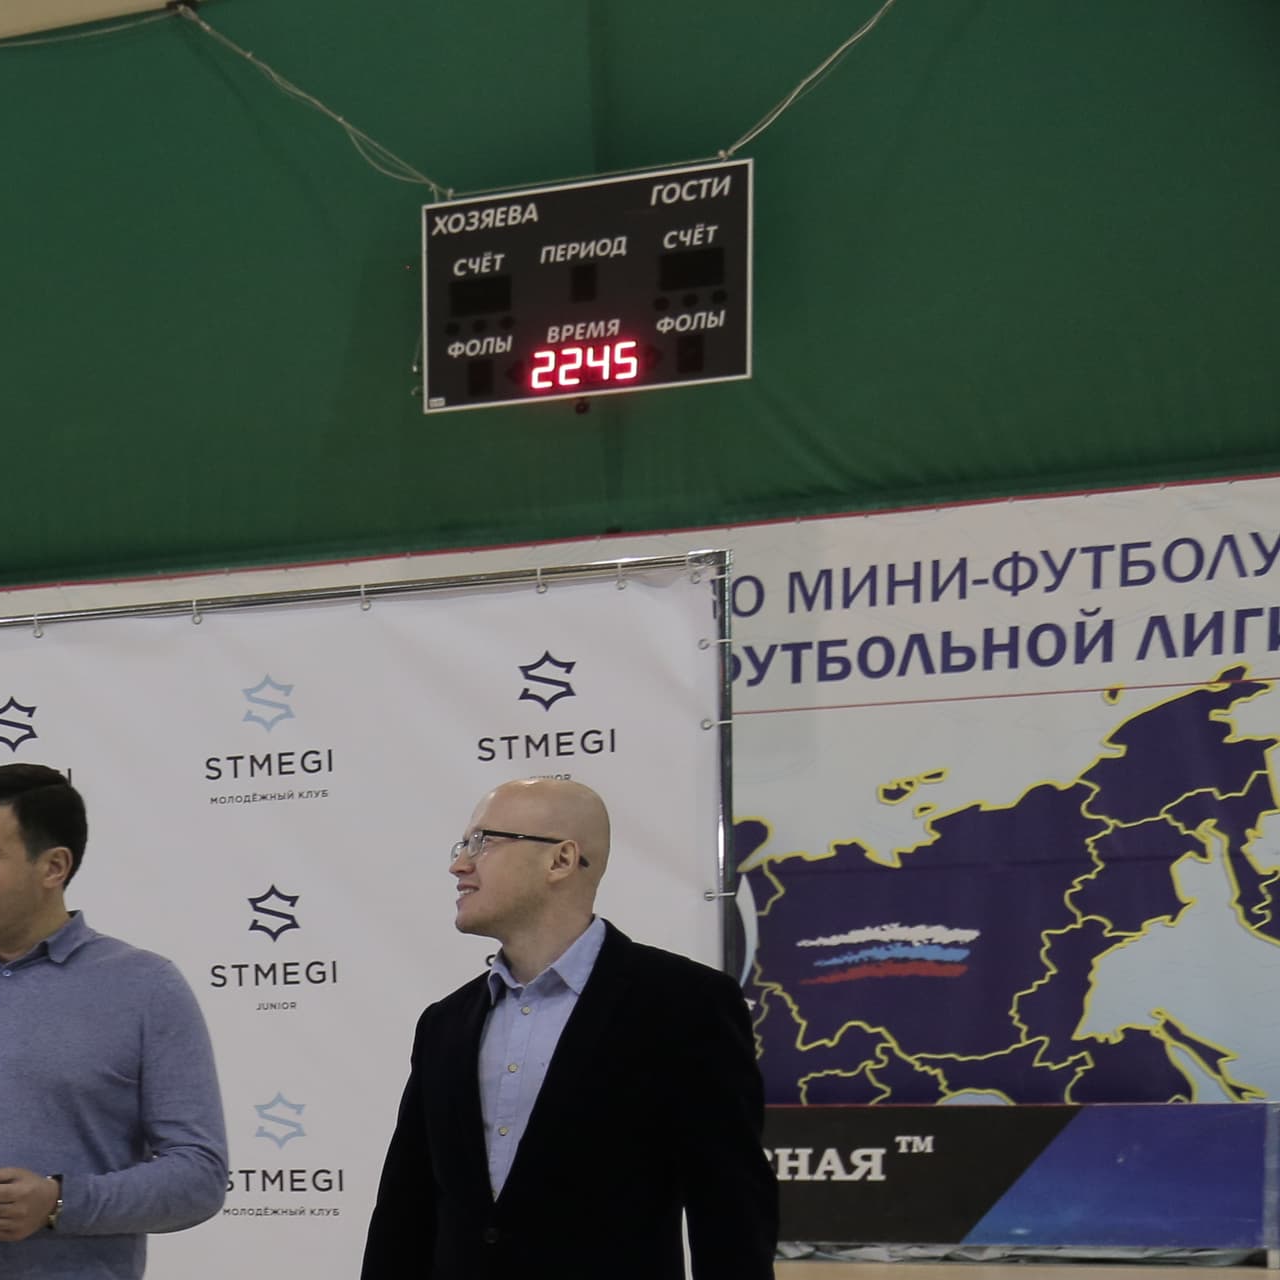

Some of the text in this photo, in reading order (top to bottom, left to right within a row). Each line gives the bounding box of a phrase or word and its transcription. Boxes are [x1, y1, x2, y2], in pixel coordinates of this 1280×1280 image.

[650, 175, 731, 206] ГОСТИ
[432, 203, 538, 236] ХОЗЯЕВА
[663, 224, 718, 249] СЧЁТ
[540, 236, 627, 264] ПЕРИОД
[453, 252, 505, 276] СЧЁТ
[547, 319, 620, 343] ВРЕМЯ
[656, 310, 726, 334] ФОЛЫ
[447, 336, 512, 358] ФОЛЫ
[531, 341, 638, 388] 2245
[787, 532, 1280, 614] МИНИ-ФУТБОЛУ
[477, 728, 616, 761] STMEGI
[205, 749, 333, 780] STMEGI
[210, 789, 329, 805] МОЛОДЁЖНЫЙ КЛУБ
[211, 960, 338, 988] STMEGI
[256, 1002, 297, 1011] JUNIOR
[223, 1206, 341, 1217] МОЛОДЁЖНЫЙ КЛУБ
